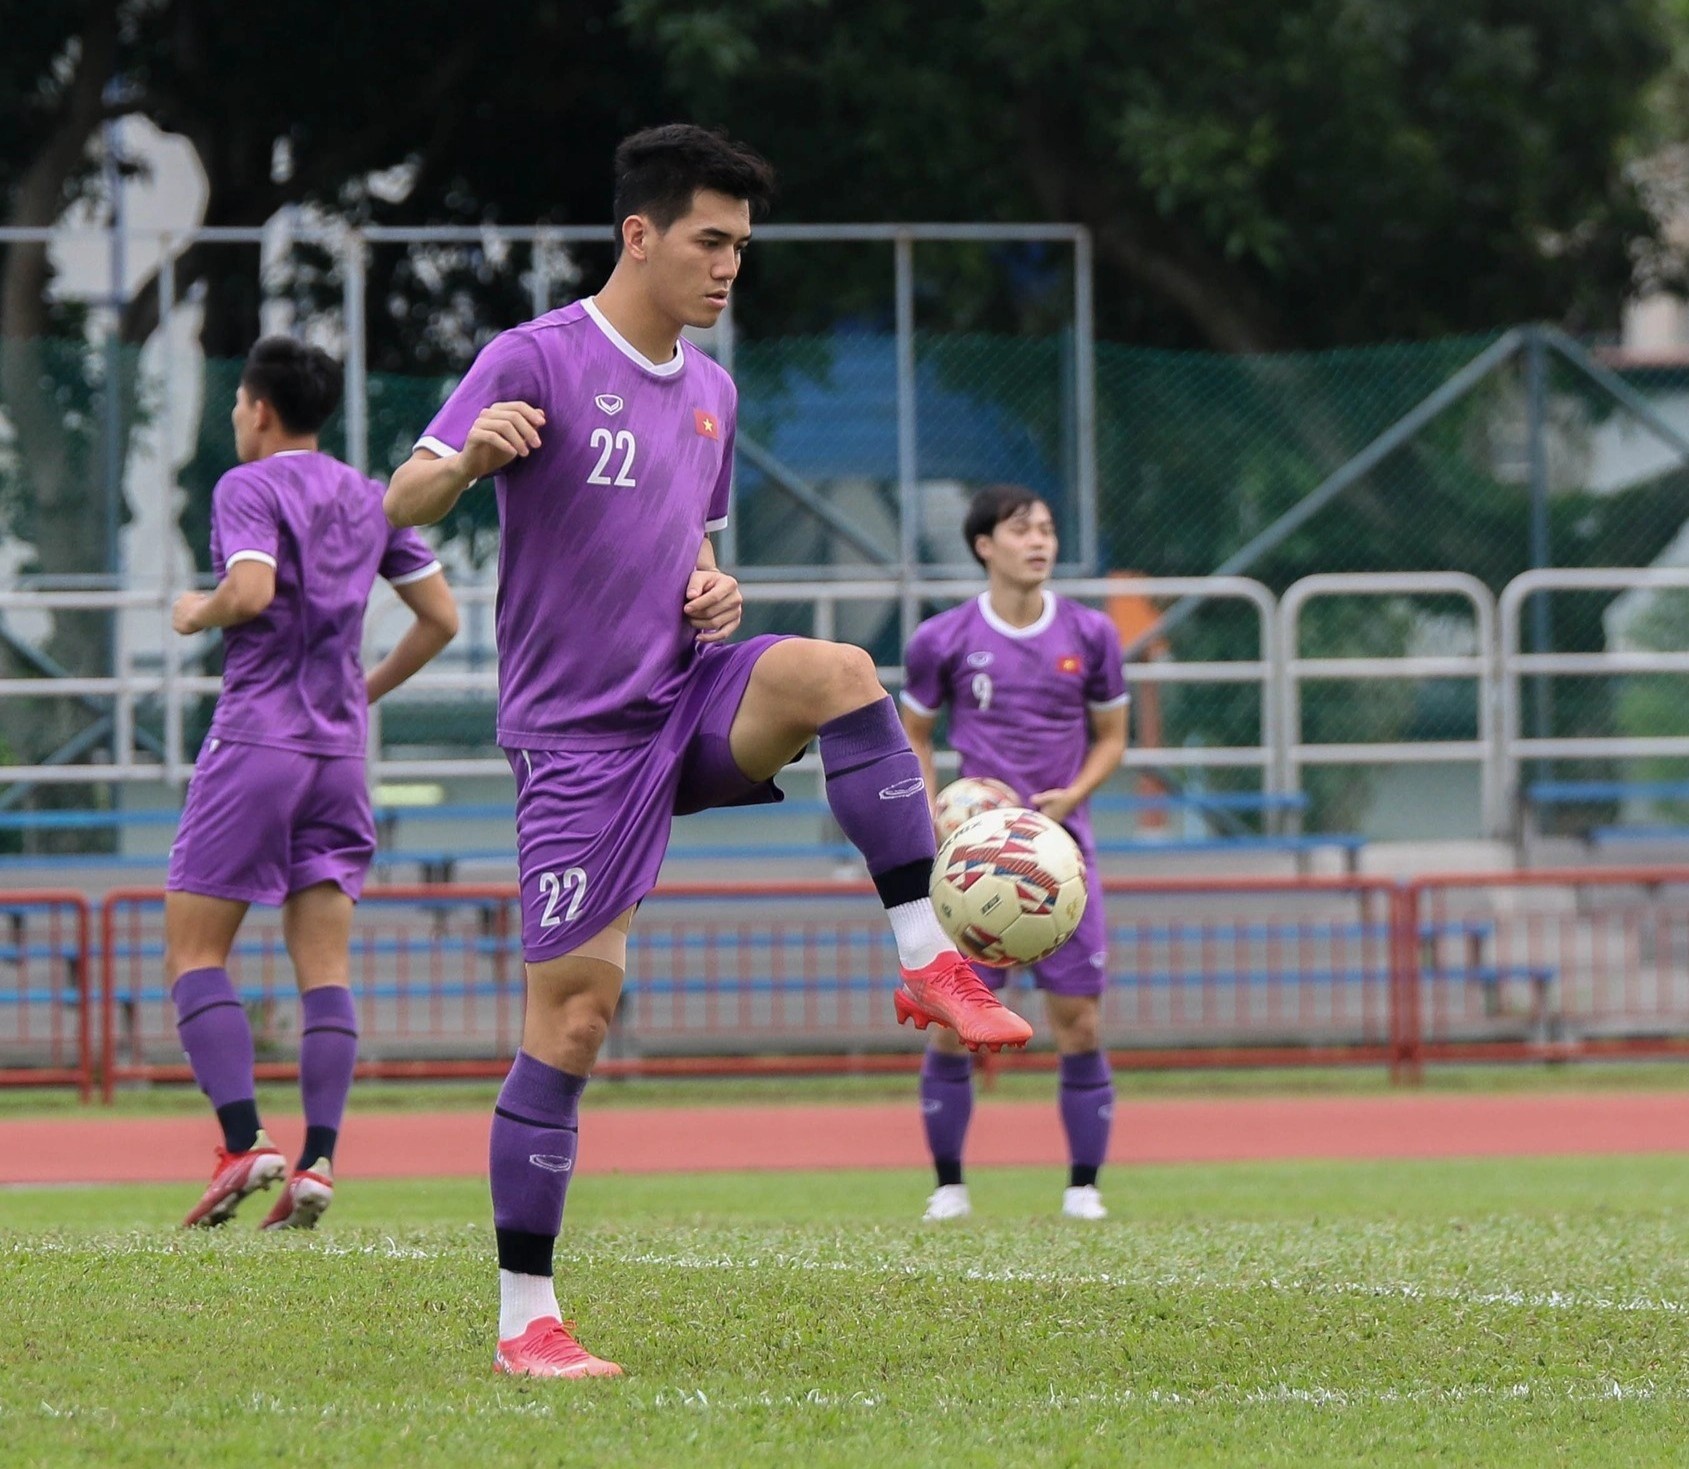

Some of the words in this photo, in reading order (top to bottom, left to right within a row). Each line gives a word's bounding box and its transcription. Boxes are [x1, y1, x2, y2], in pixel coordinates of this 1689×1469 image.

[586, 428, 636, 487] 22
[971, 673, 993, 711] 9
[539, 867, 587, 927] 22
